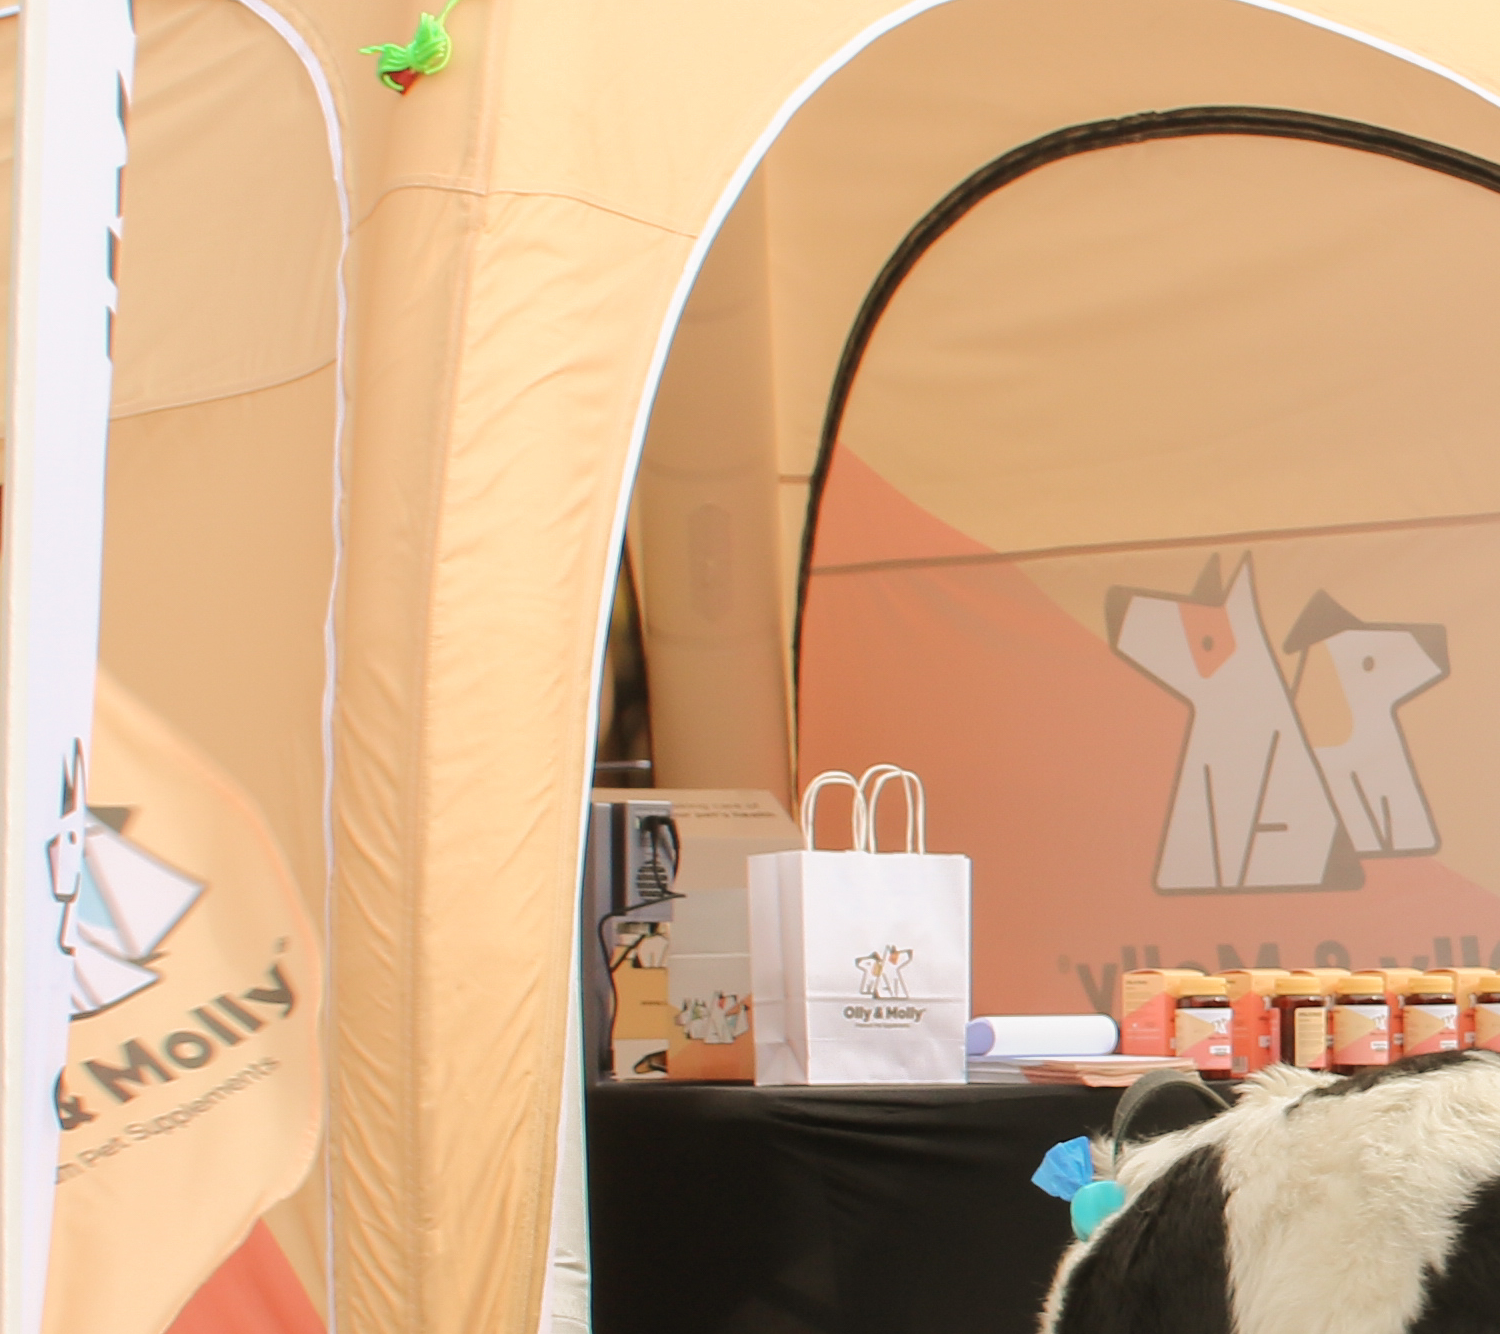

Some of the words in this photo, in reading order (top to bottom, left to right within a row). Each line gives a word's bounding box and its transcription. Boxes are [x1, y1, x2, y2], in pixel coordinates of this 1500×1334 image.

[81, 963, 296, 1103] Molly
[843, 1006, 872, 1022] Olly
[885, 1006, 925, 1022] Molly
[77, 1136, 130, 1165] Pet
[125, 1056, 280, 1142] Supplements
